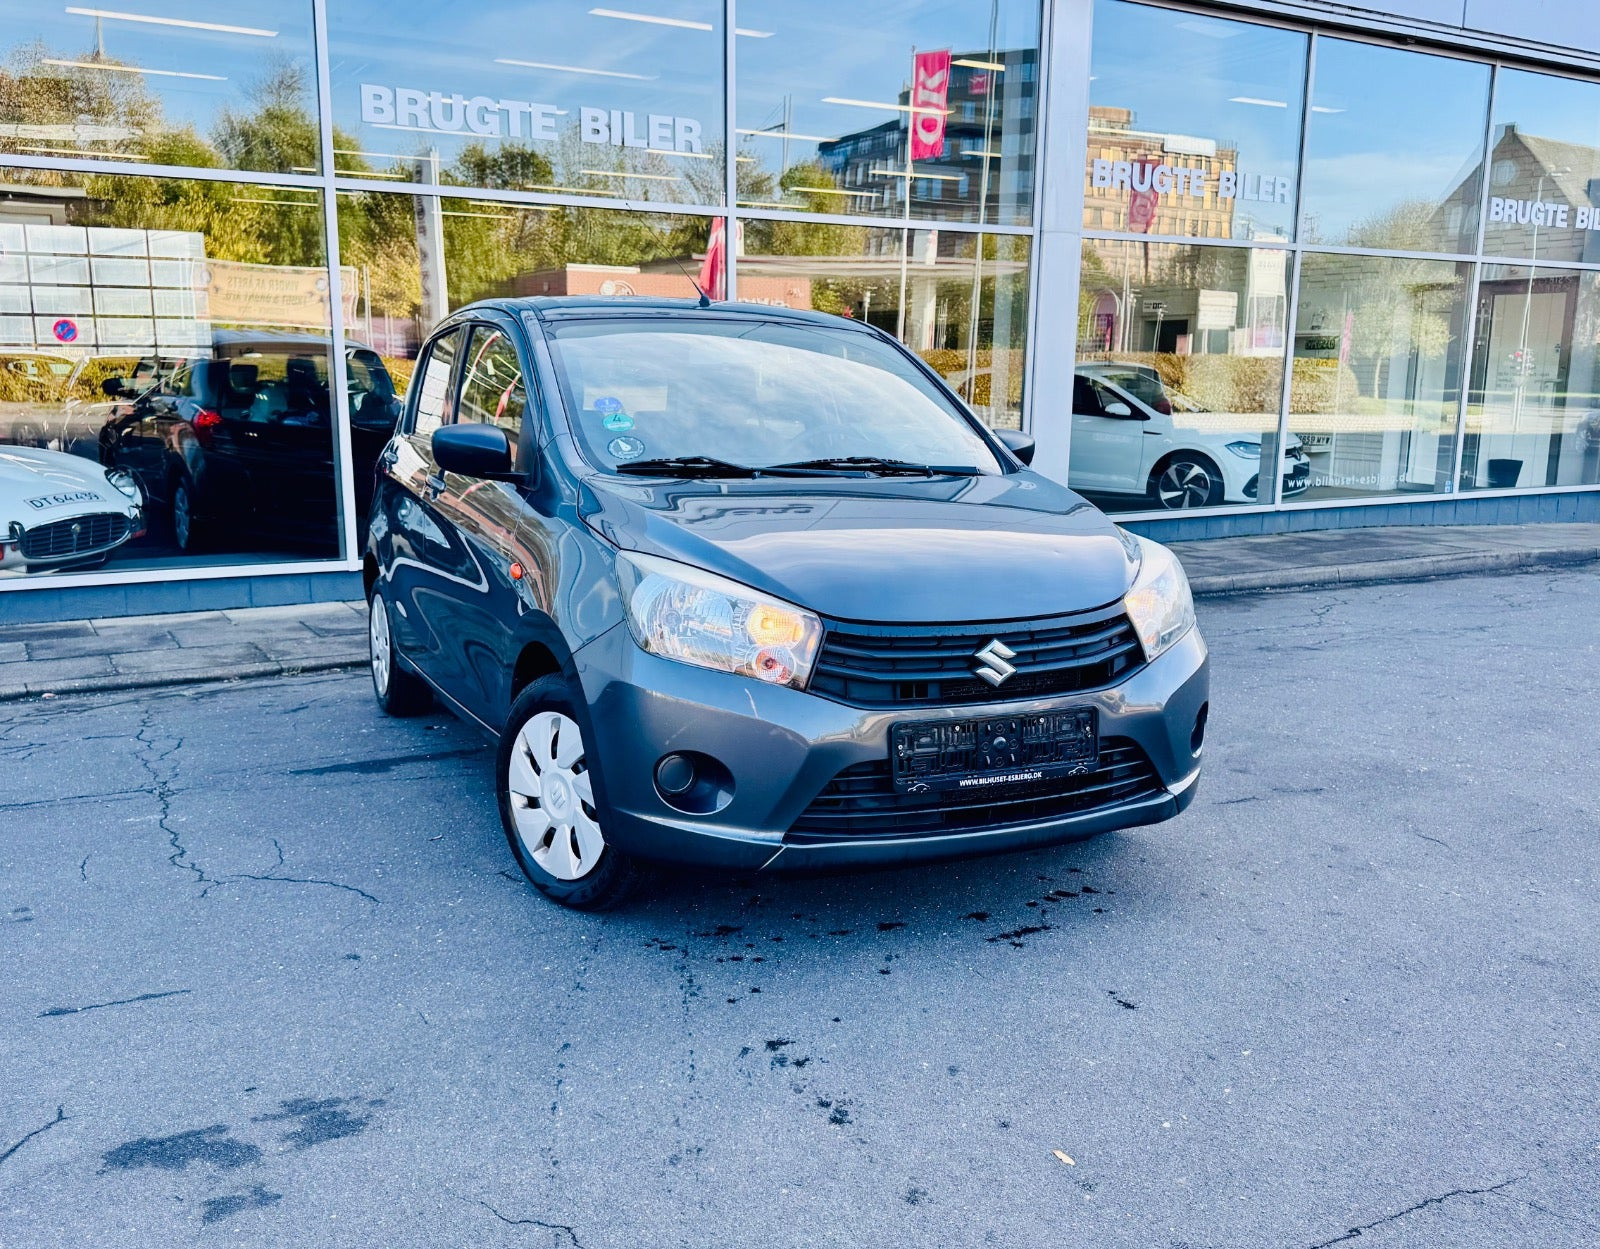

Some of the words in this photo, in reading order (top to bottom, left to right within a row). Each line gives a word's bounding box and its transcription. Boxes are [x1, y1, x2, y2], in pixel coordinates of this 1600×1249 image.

[360, 83, 559, 141] BRUGTE
[580, 106, 702, 153] BILER
[1092, 159, 1206, 197] BRUGTE
[1219, 171, 1291, 203] BILER
[1489, 197, 1569, 228] BRUGTE
[1288, 472, 1411, 488] www.bilhuset-esbjg.d
[29, 497, 52, 508] DT
[959, 772, 1042, 786] WWW.BILHUSET-ESBJERG.DK
